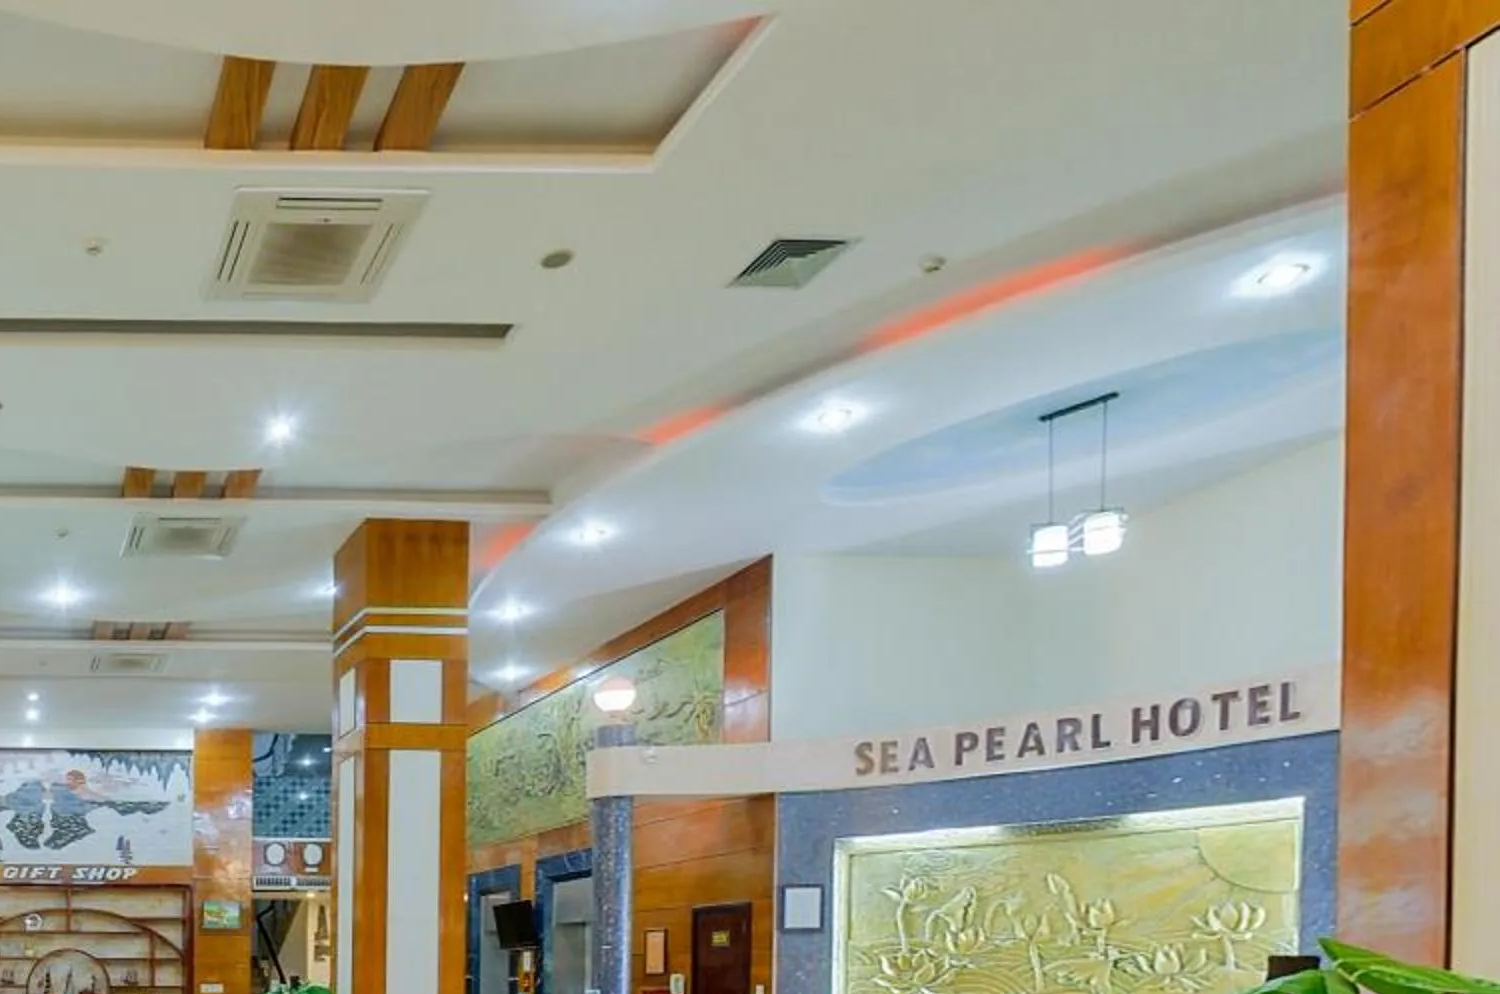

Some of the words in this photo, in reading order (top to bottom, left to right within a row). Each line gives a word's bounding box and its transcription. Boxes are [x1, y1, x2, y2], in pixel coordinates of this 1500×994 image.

[853, 736, 936, 777] SEA
[953, 713, 1112, 767] PEARL
[1130, 681, 1302, 744] HOTEL
[2, 865, 63, 880] GIFT
[71, 866, 138, 881] SHOP
